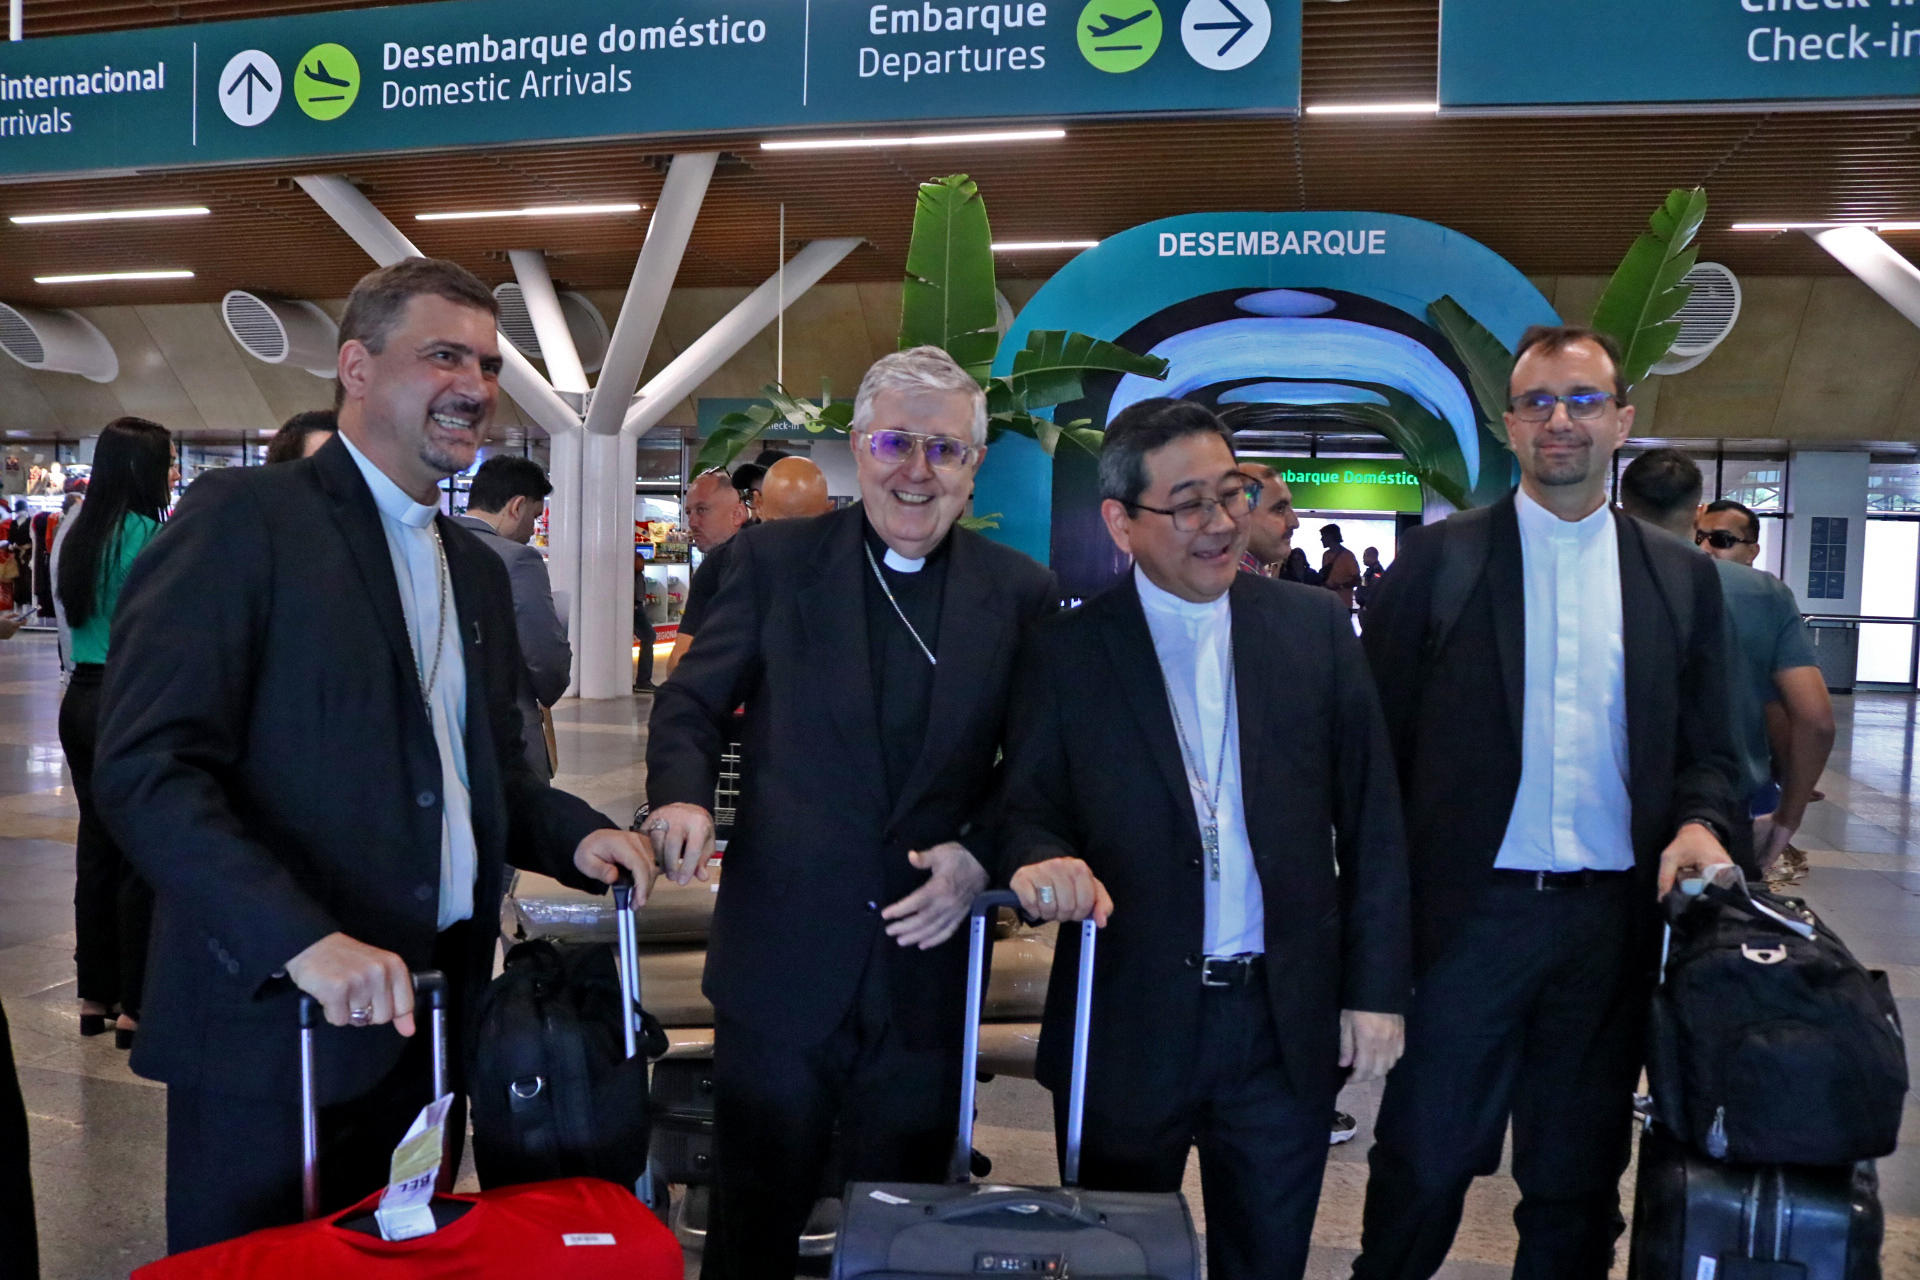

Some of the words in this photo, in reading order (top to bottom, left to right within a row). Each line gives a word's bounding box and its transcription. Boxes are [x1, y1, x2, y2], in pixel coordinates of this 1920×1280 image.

[869, 1, 1047, 35] Embarque
[383, 33, 588, 71] Desembarque
[598, 15, 767, 53] doméstico
[1, 62, 165, 100] internacional
[859, 45, 1046, 82] Departures
[382, 72, 510, 109] Domestic
[520, 63, 632, 98] Arrivals
[1159, 230, 1386, 256] DESEMBARQUE
